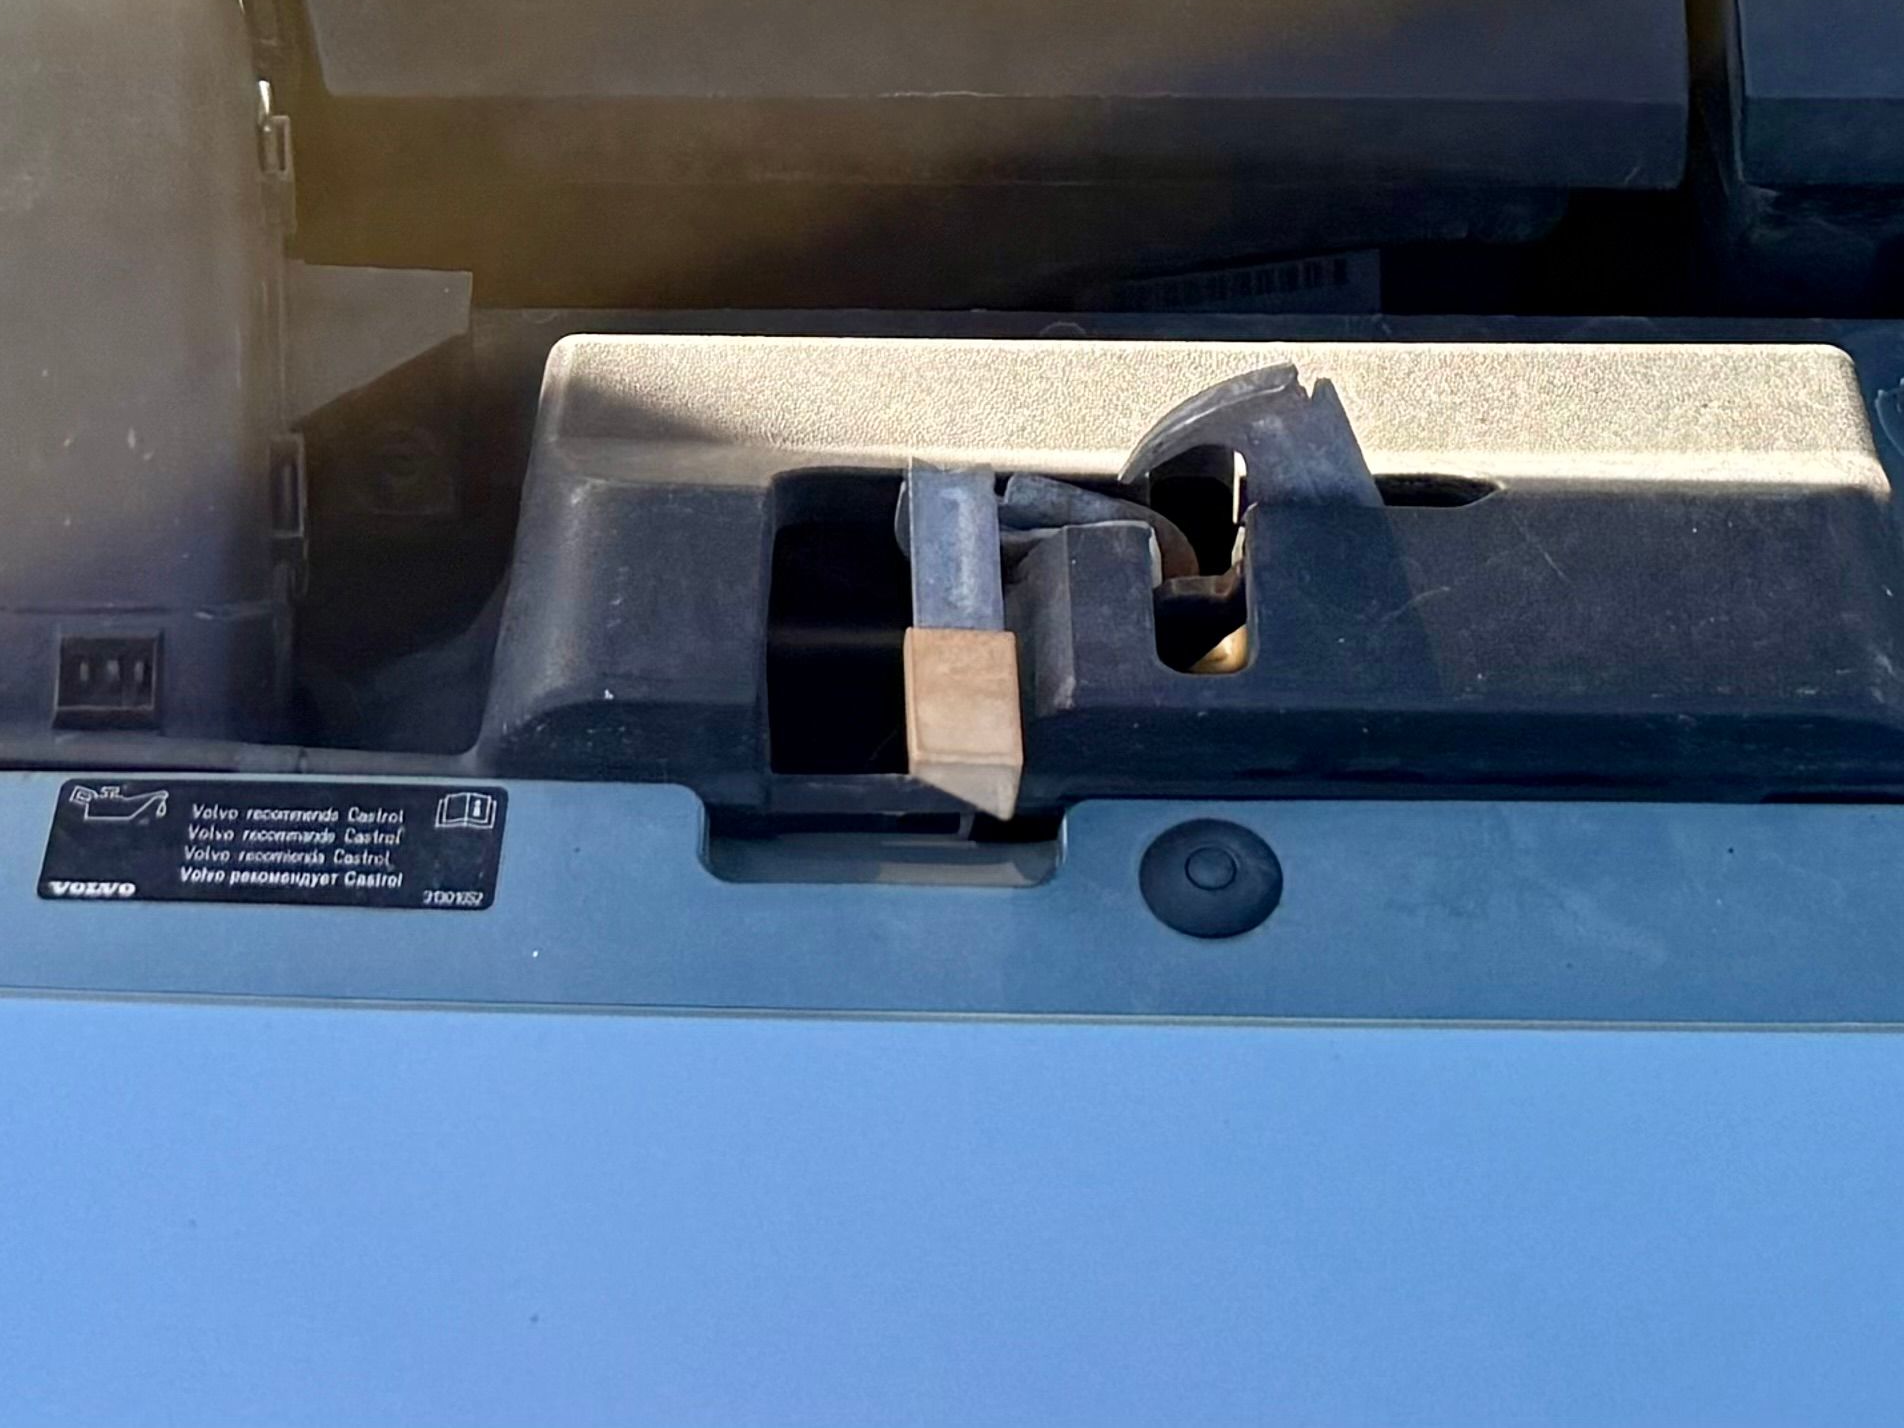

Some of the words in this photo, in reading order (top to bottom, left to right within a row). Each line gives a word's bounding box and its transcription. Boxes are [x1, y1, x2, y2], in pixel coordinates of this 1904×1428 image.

[192, 803, 239, 821] Volvo
[347, 806, 405, 824] Castrol
[187, 823, 235, 841] Volvo
[344, 826, 406, 845] Castrol
[183, 844, 231, 862] Volvo
[333, 847, 392, 867] Castrol
[179, 865, 226, 883] Volvo
[344, 870, 405, 888] Castrol
[48, 880, 137, 898] VOLVO
